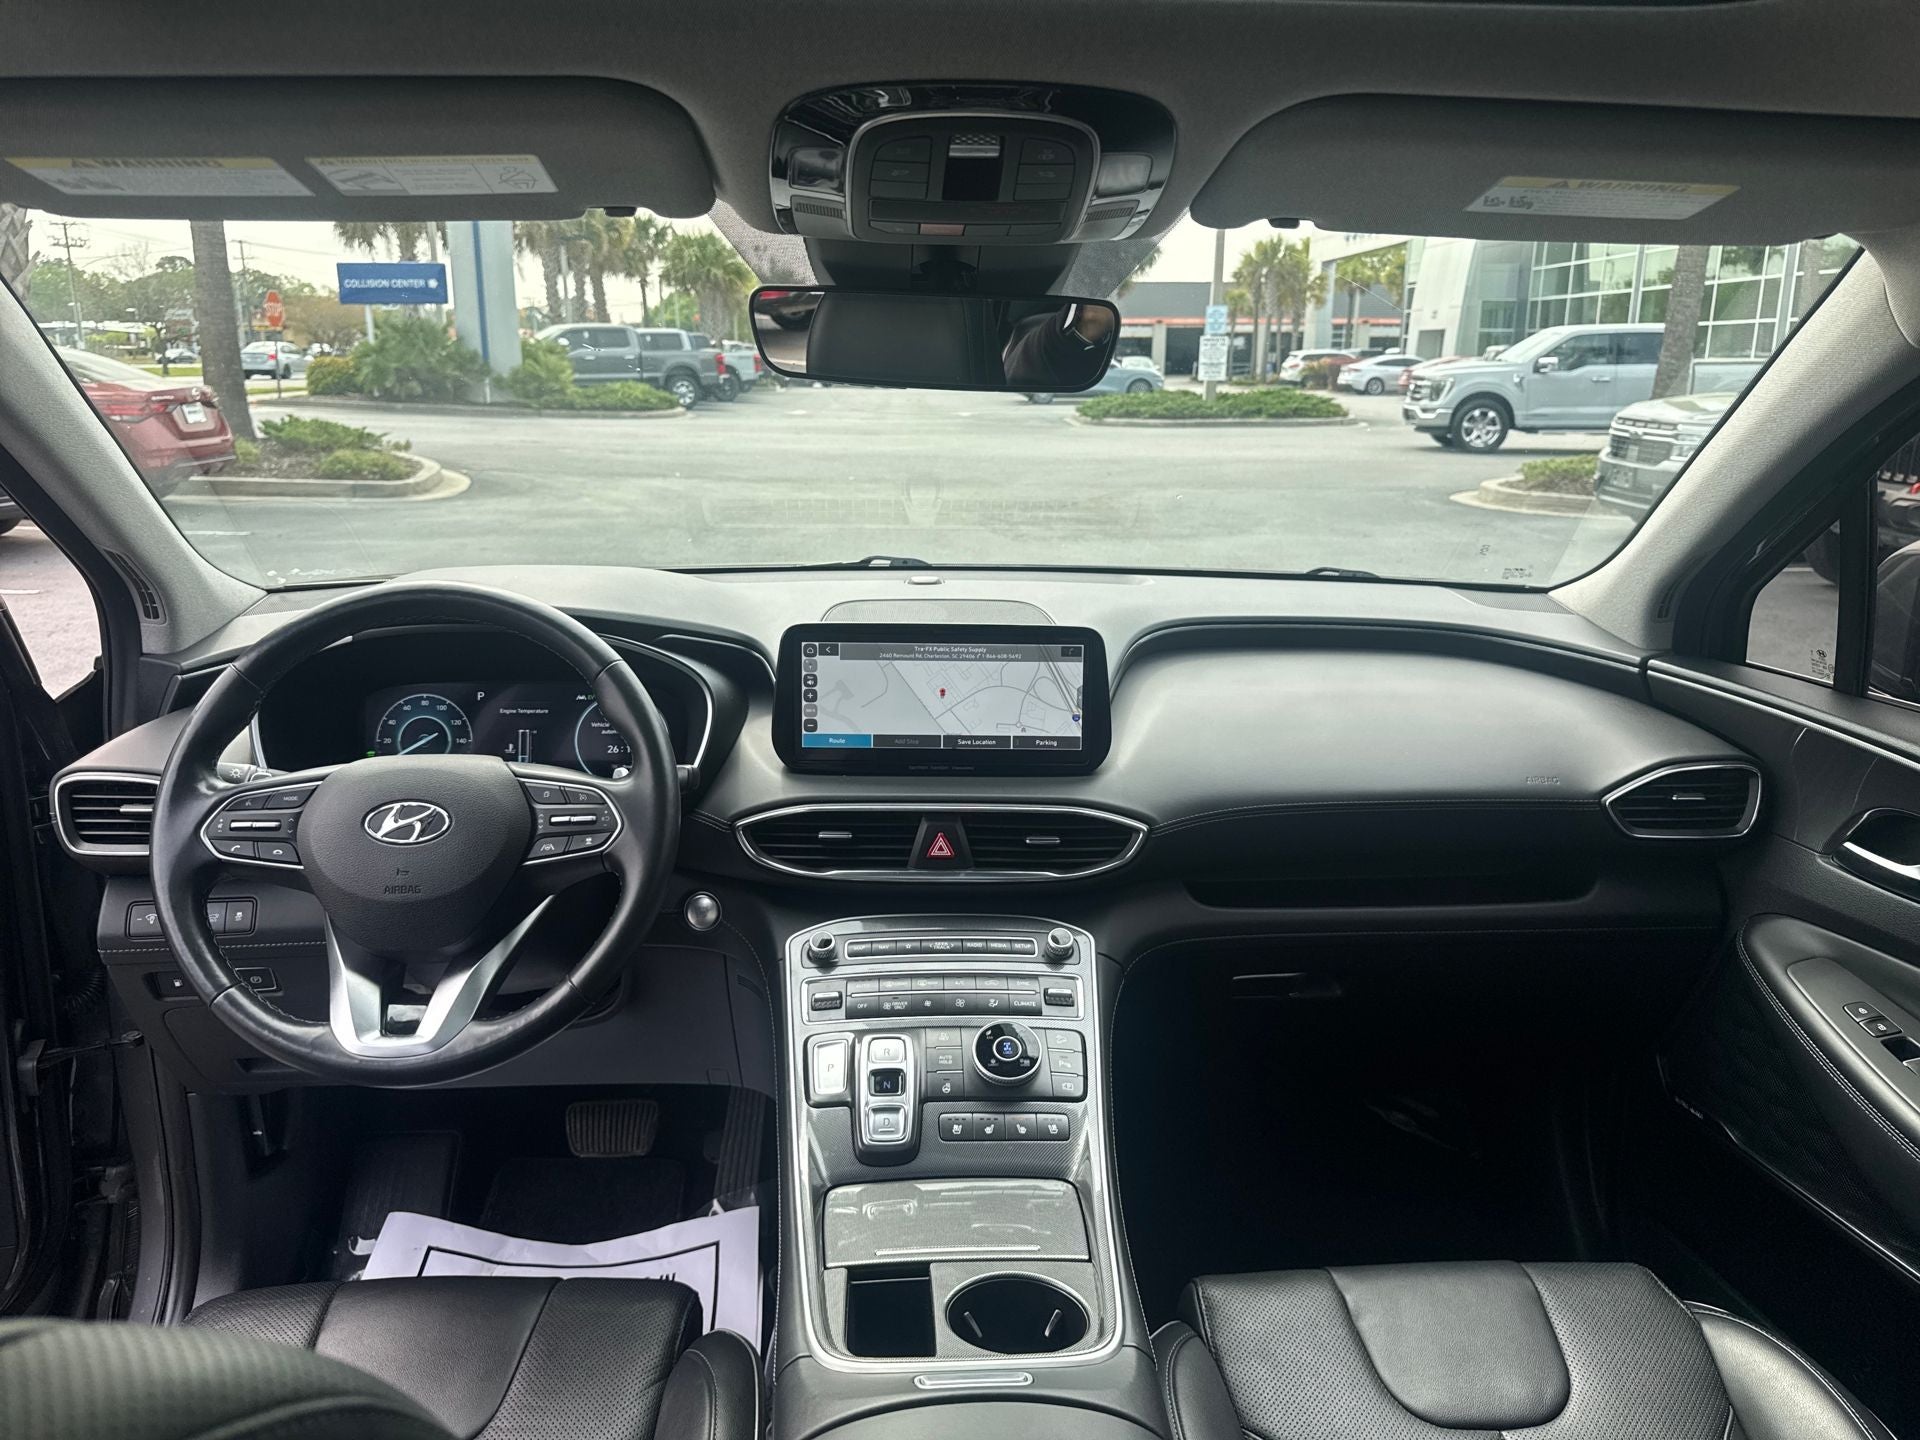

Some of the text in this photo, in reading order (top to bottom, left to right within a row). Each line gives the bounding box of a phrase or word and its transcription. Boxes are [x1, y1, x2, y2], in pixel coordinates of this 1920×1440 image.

[1577, 180, 1692, 193] WARNING
[344, 278, 426, 289] COLLISION CENTER
[264, 303, 283, 316] STOP
[969, 646, 987, 654] Supply
[477, 691, 485, 701] P
[1036, 739, 1057, 747] Parking
[384, 885, 421, 894] AIRBAG
[883, 1048, 891, 1056] R
[827, 1063, 835, 1073] P
[883, 1080, 891, 1089] N
[883, 1117, 891, 1126] D
